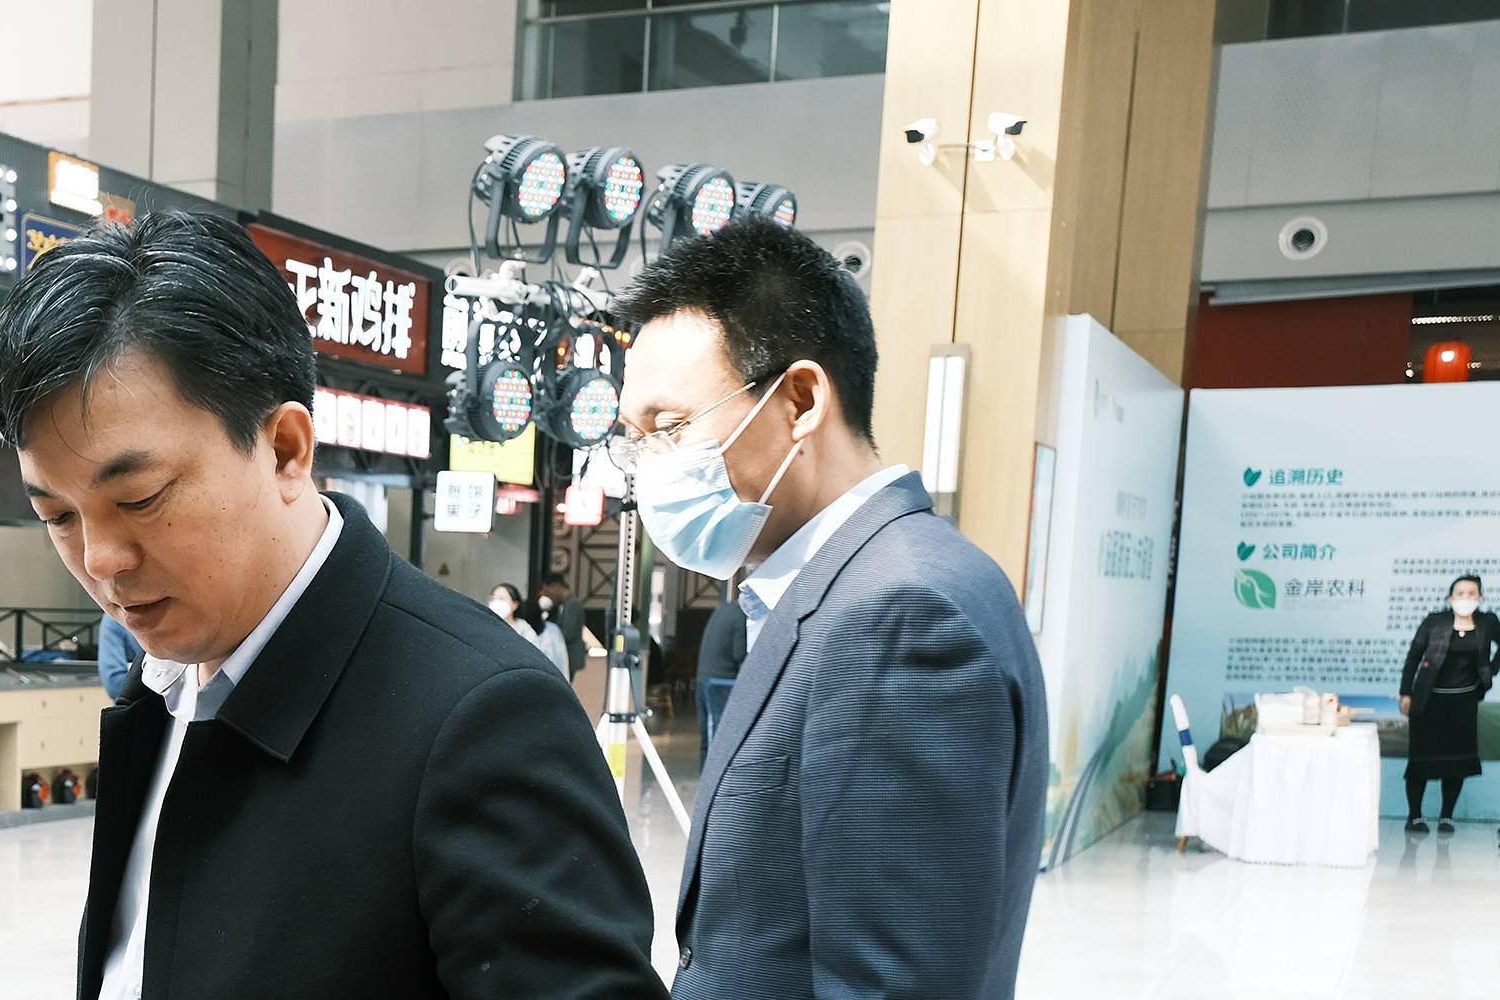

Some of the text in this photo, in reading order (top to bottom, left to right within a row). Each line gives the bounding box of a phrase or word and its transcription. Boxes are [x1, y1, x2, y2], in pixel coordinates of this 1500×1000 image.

[285, 256, 416, 360] 正新鸡排
[1269, 468, 1344, 486] 追溯历史
[1262, 543, 1337, 561] 公司简介
[1284, 577, 1365, 598] 金岸农科
